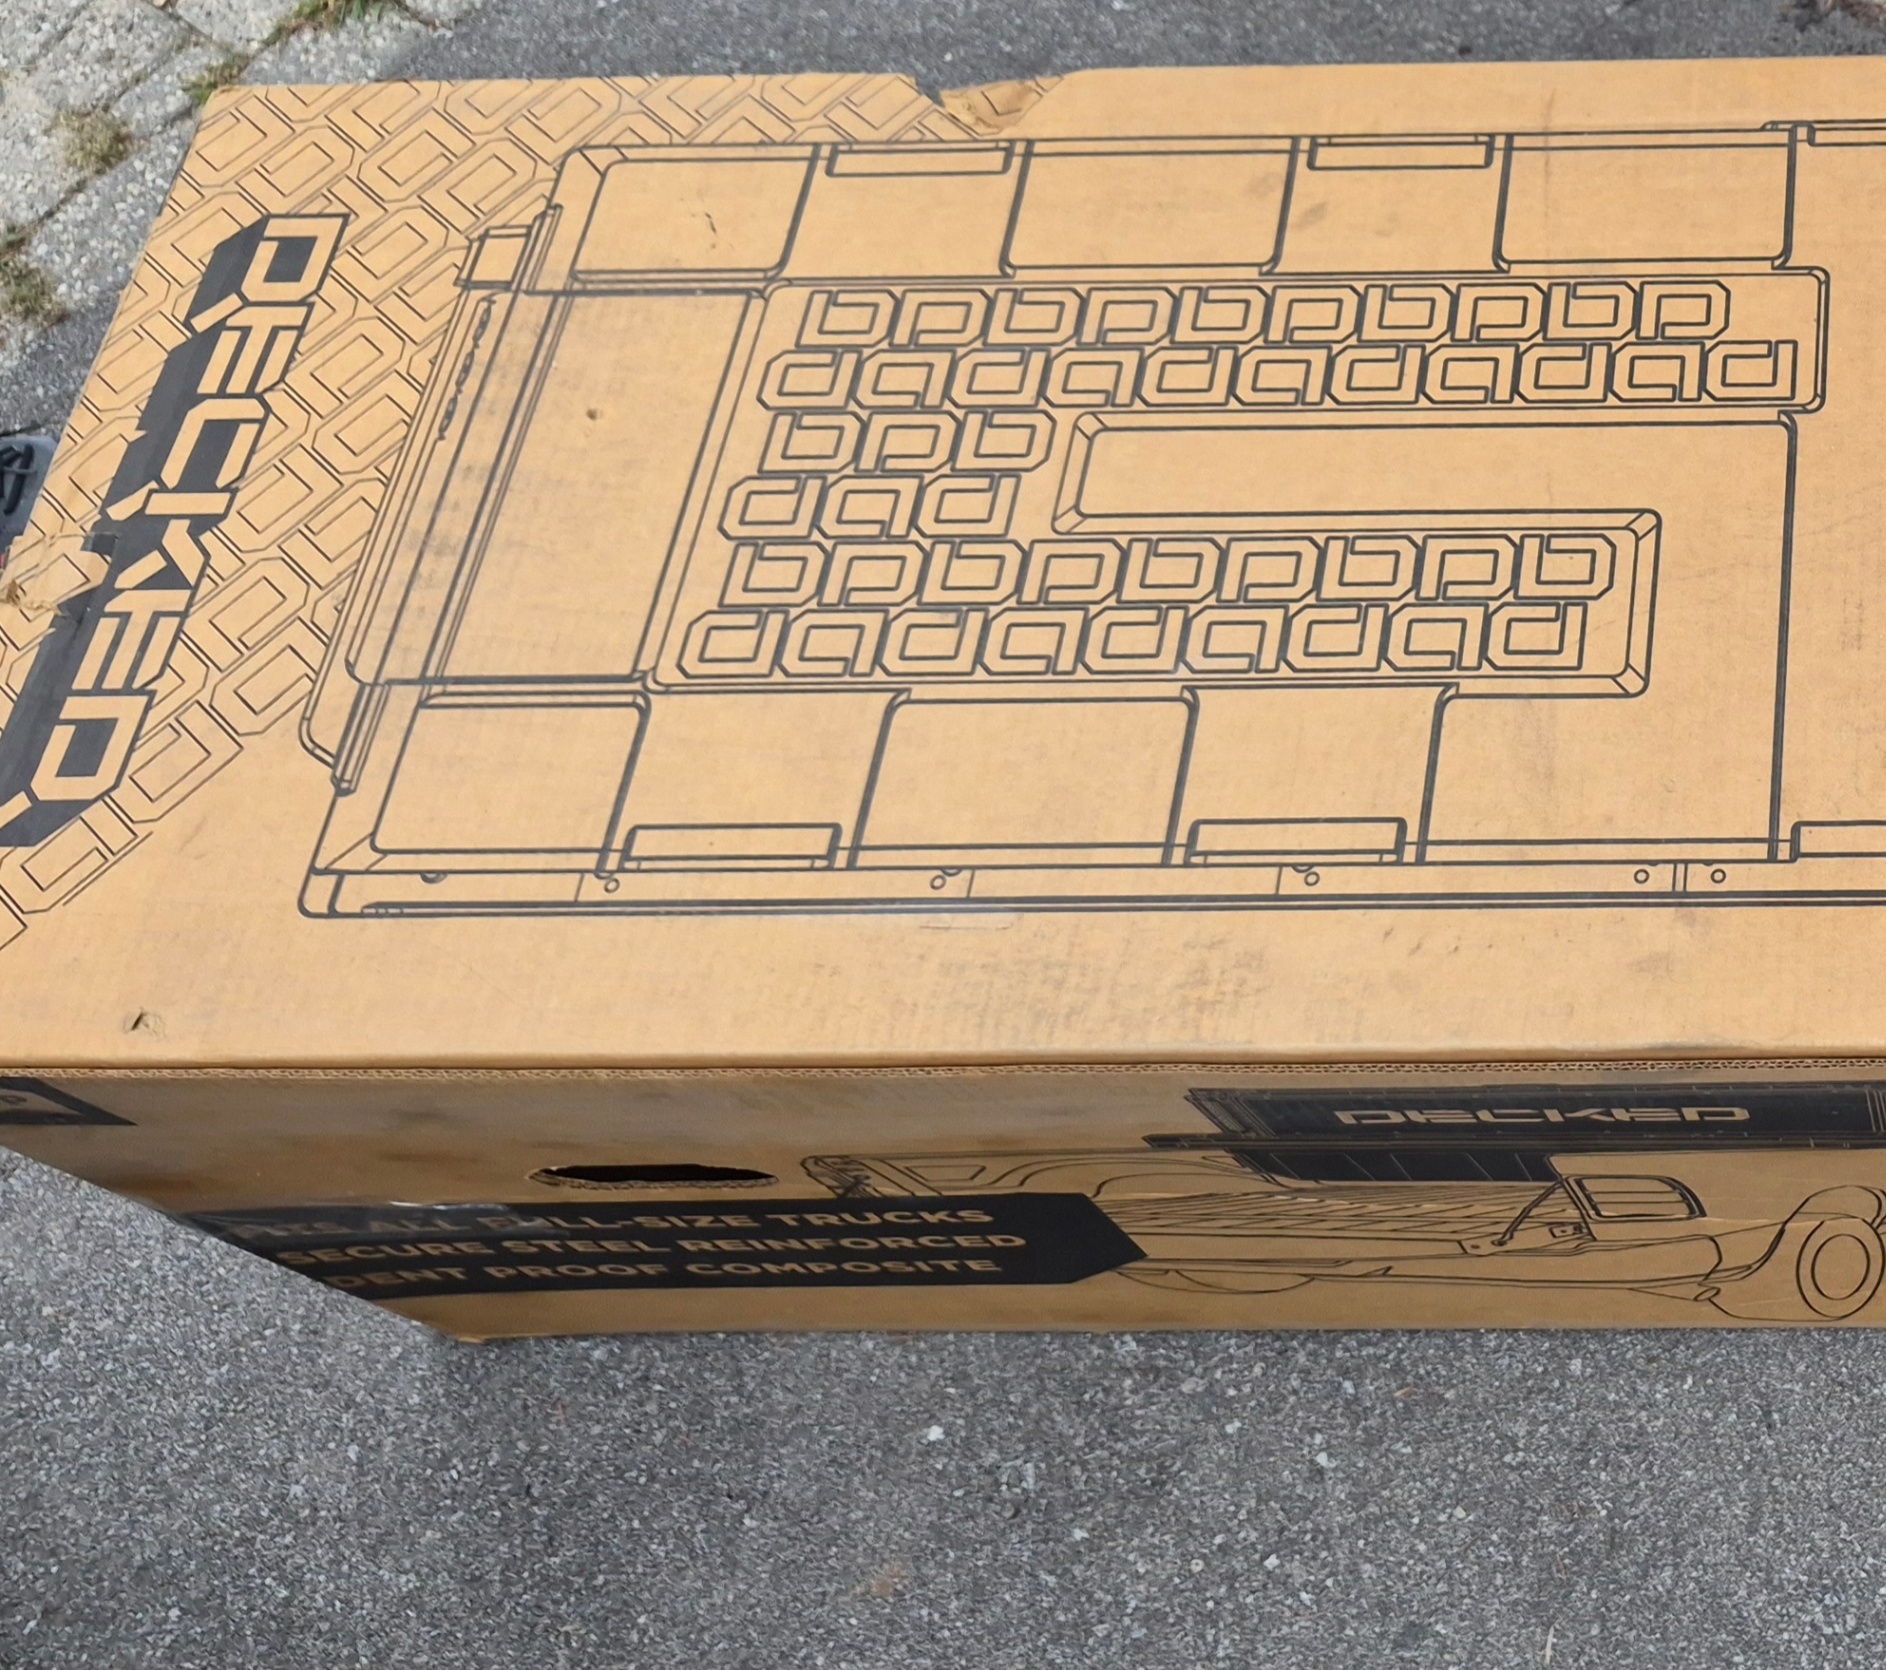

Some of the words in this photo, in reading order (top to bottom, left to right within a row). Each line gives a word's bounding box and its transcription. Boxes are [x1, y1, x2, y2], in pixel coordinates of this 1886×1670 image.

[0, 212, 350, 846] DECKED
[1333, 1106, 1751, 1124] DECKED
[366, 1218, 474, 1234] ALL
[476, 1215, 762, 1230] FULL-SIZE
[765, 1210, 995, 1228] TRUCKS
[276, 1240, 495, 1265] SECURE
[501, 1239, 672, 1254] STEEL
[676, 1234, 1027, 1252] REINFORCED
[323, 1266, 468, 1288] DENT
[483, 1263, 669, 1279] PROOF
[684, 1259, 1002, 1276] COMPOSITE
